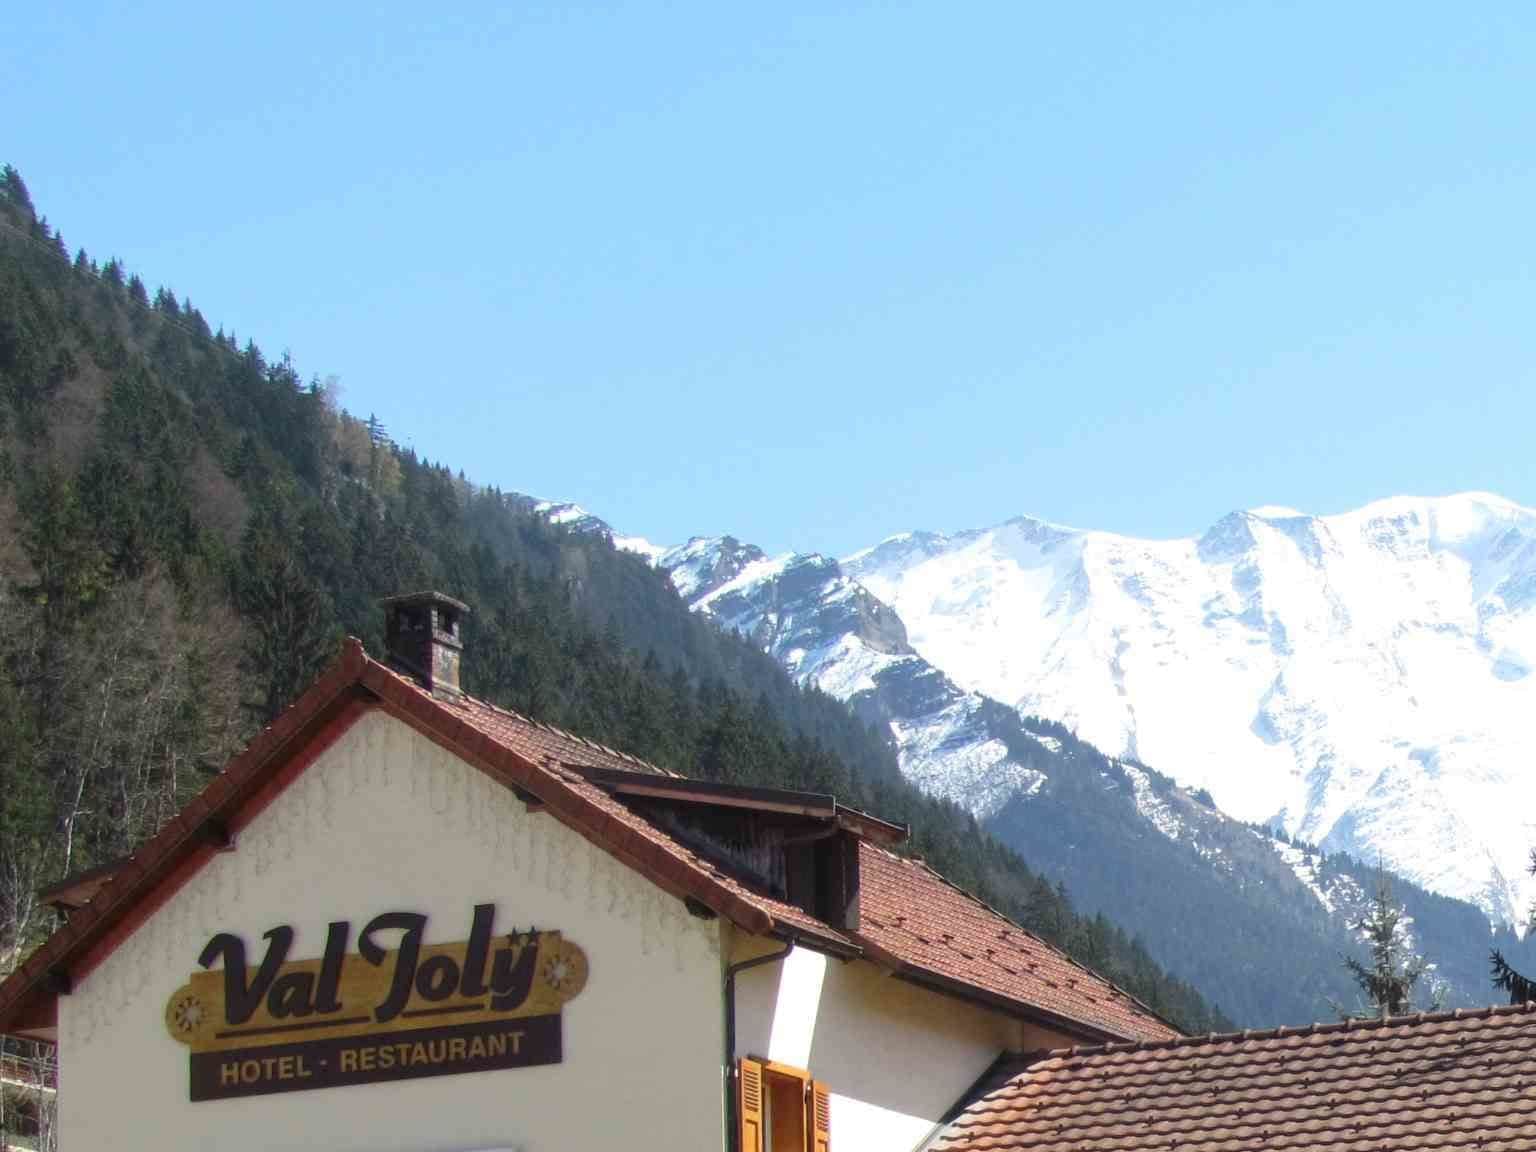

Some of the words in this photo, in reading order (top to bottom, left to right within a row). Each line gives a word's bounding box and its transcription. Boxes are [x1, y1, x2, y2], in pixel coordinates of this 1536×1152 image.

[198, 921, 349, 1025] Val
[358, 903, 538, 1024] Joly
[221, 1056, 312, 1086] HOTEL
[340, 1031, 526, 1074] RESTAURANT
